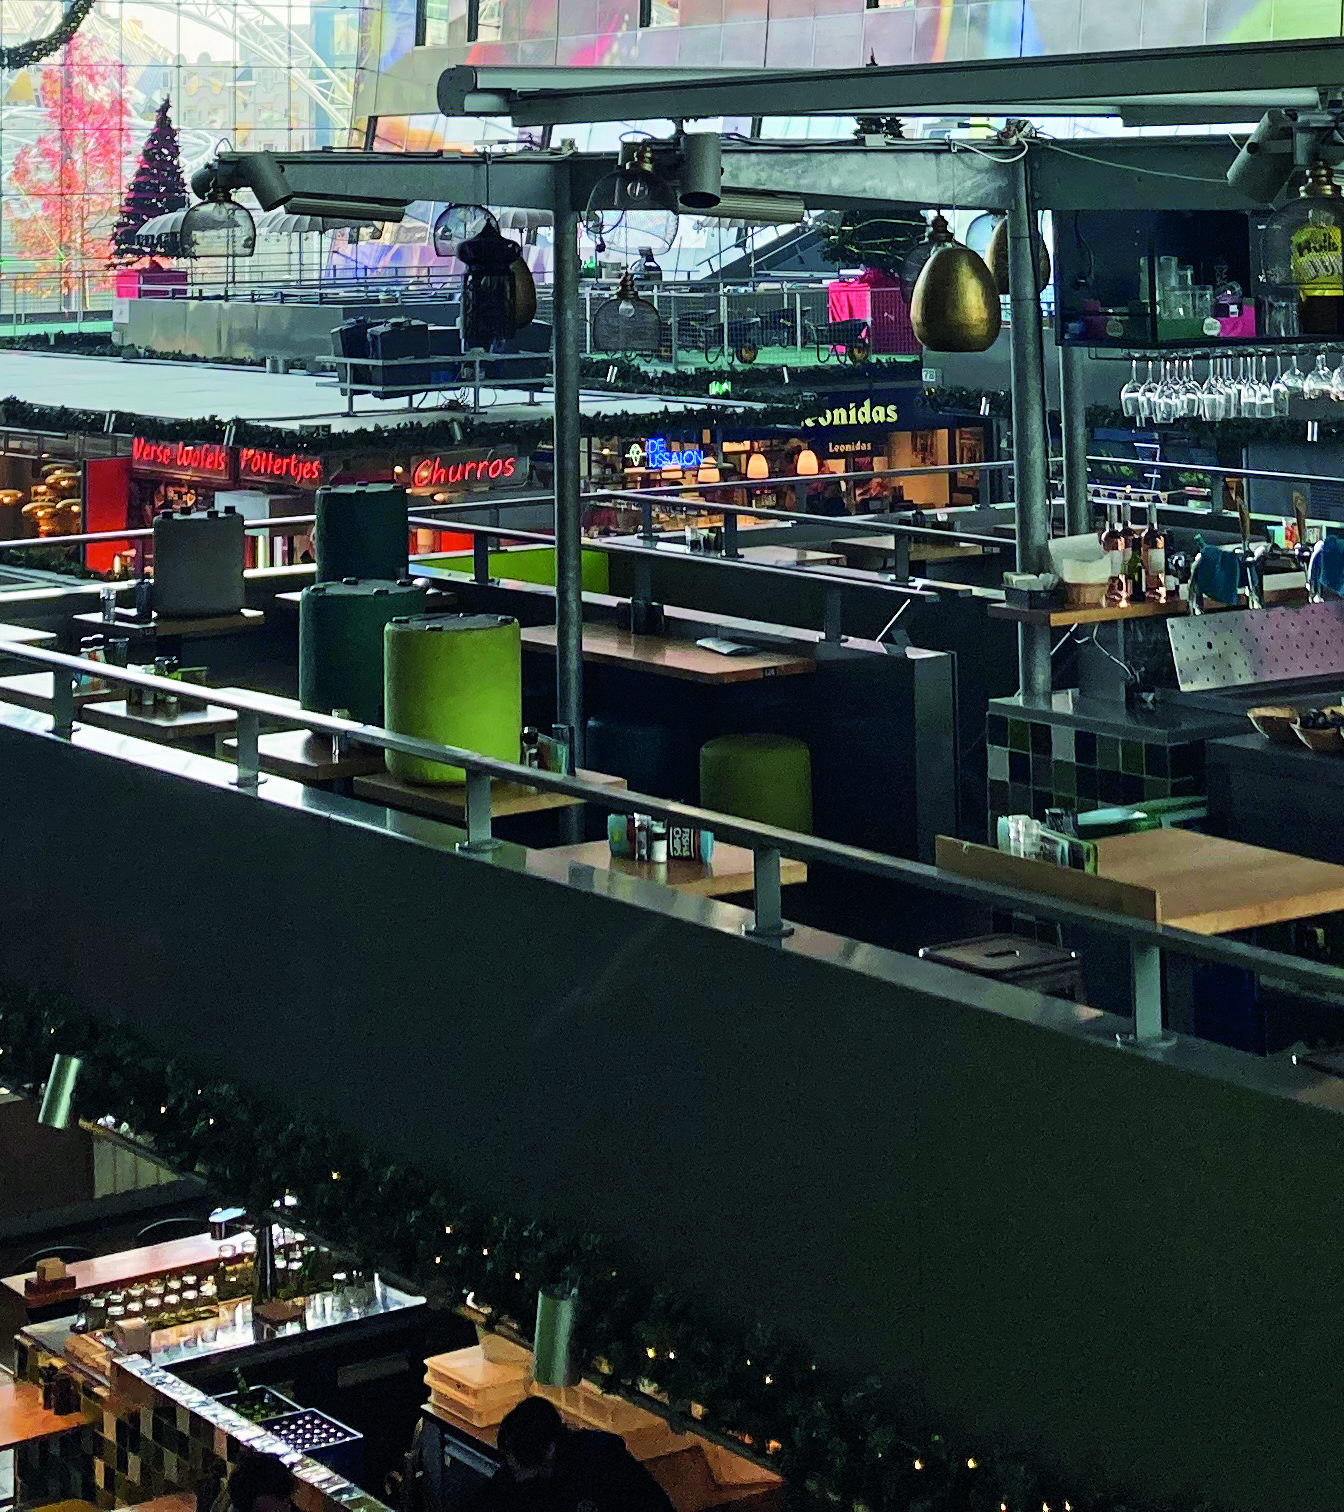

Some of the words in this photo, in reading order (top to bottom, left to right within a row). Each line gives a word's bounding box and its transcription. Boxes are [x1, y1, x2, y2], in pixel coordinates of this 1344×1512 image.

[132, 436, 171, 465] Verse
[648, 438, 665, 453] DE
[828, 439, 872, 454] Leonidas
[413, 455, 516, 488] Churros
